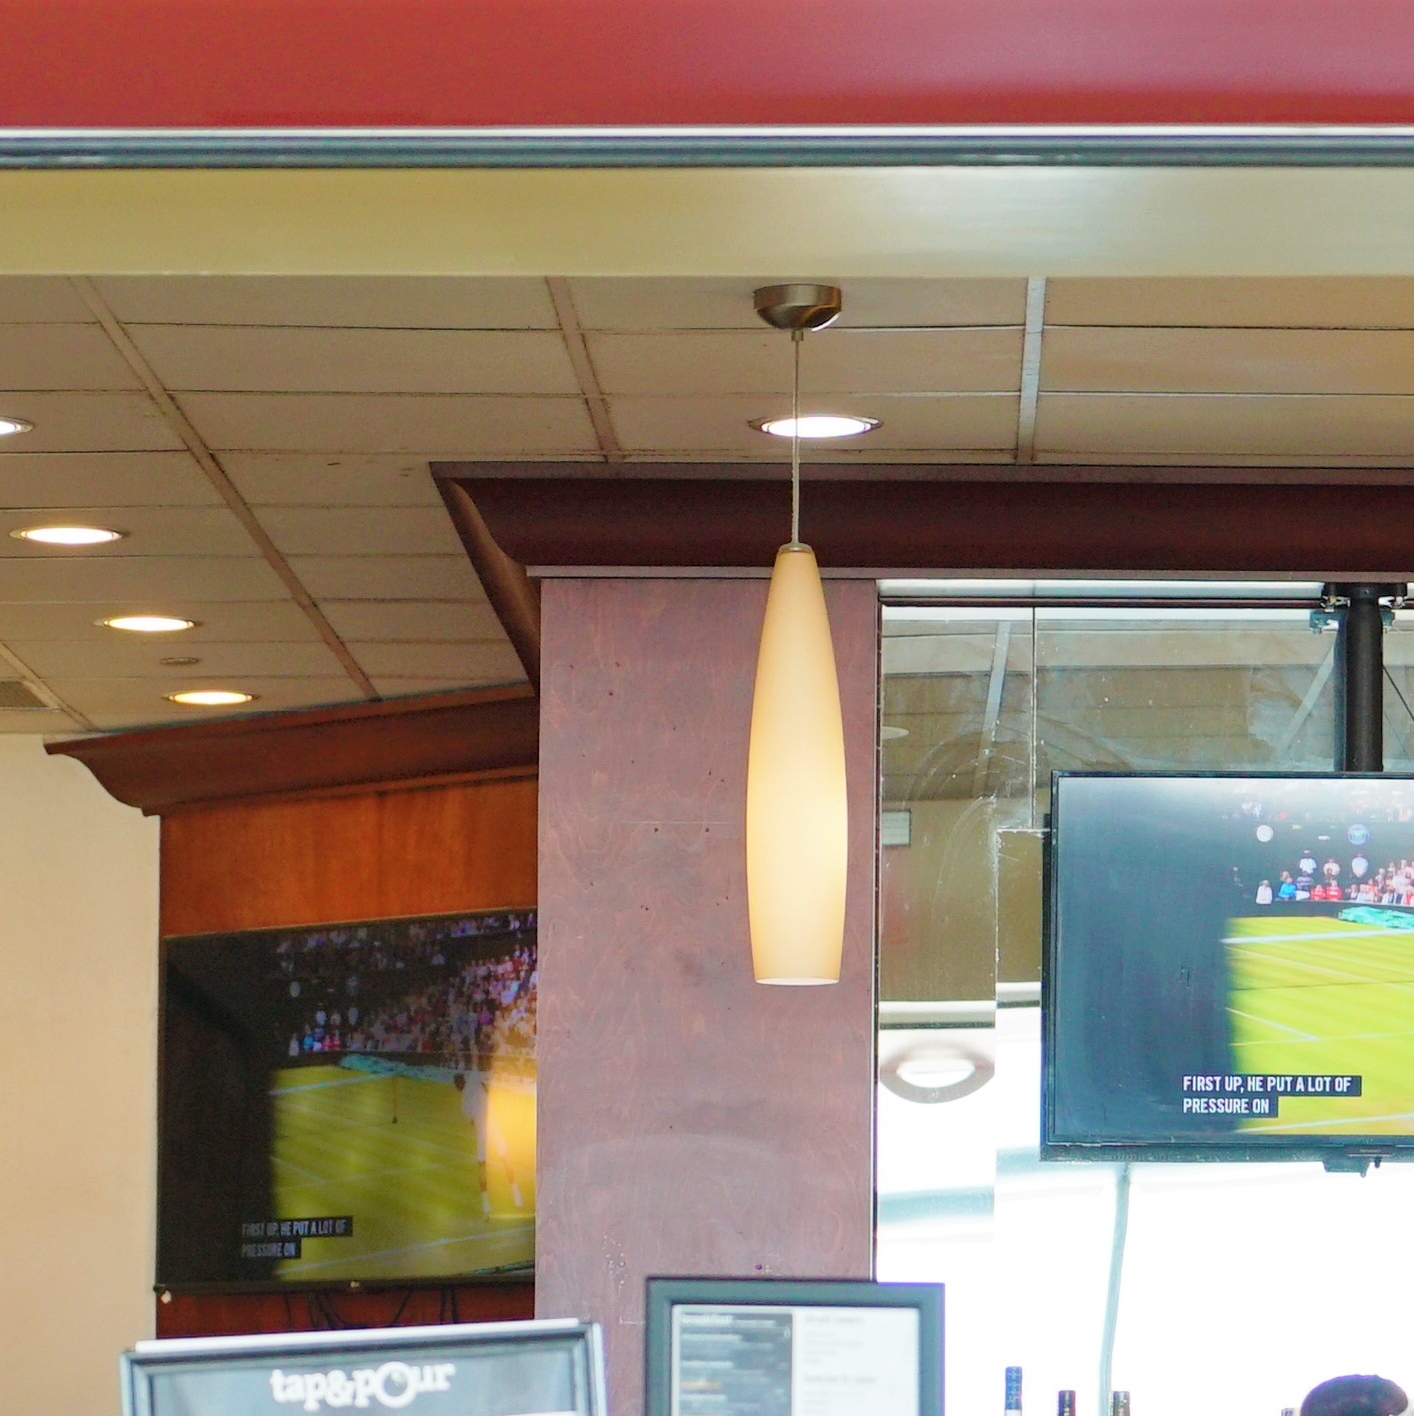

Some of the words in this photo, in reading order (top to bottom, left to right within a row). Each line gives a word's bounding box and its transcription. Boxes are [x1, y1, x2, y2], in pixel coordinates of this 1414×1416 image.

[1183, 1076, 1222, 1091] FIRST
[1225, 1076, 1244, 1094] UP,
[1247, 1076, 1264, 1091] HE
[1267, 1077, 1295, 1092] PUT
[1295, 1077, 1305, 1092] A
[1308, 1077, 1332, 1092] LOT
[1335, 1077, 1352, 1092] OF
[1183, 1098, 1249, 1113] PRESSURE
[1252, 1098, 1269, 1113] ON
[293, 1220, 309, 1235] PUT
[311, 1220, 318, 1234] A
[318, 1219, 333, 1234] LOT
